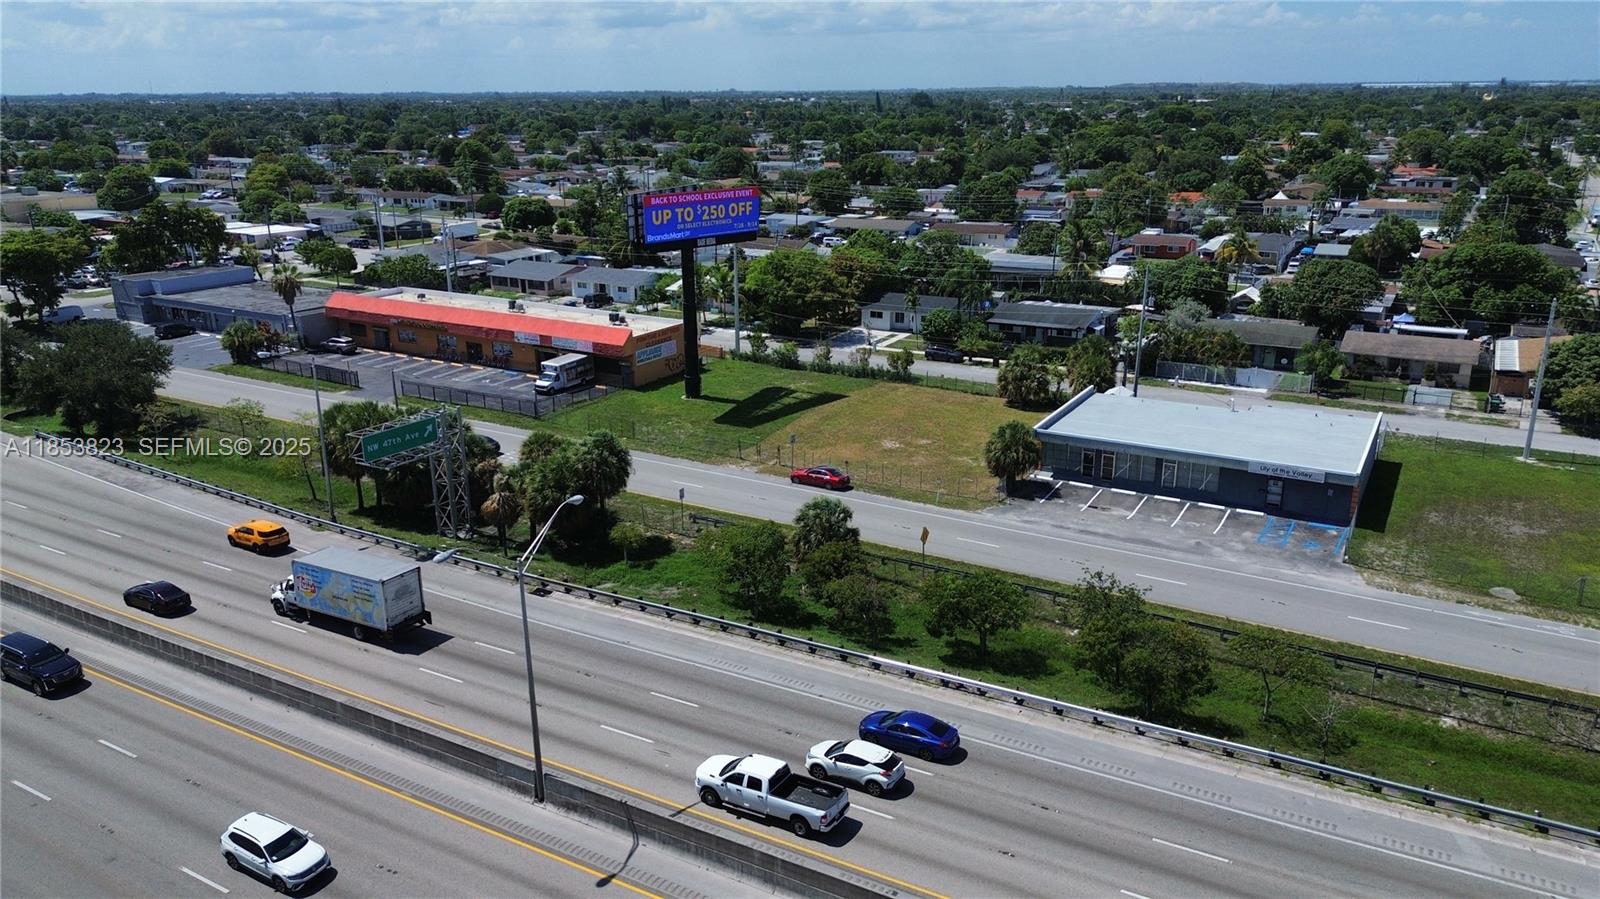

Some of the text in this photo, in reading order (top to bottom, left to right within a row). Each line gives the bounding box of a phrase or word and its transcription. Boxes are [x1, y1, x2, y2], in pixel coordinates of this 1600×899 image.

[651, 189, 753, 205] BACK TO SCHOOL EXCLUSIVE EVENT
[652, 201, 753, 225] UP TO $250 OFF
[647, 231, 684, 242] BrandsMart
[367, 431, 420, 453] NW 47th Ave
[1292, 470, 1313, 479] Valley
